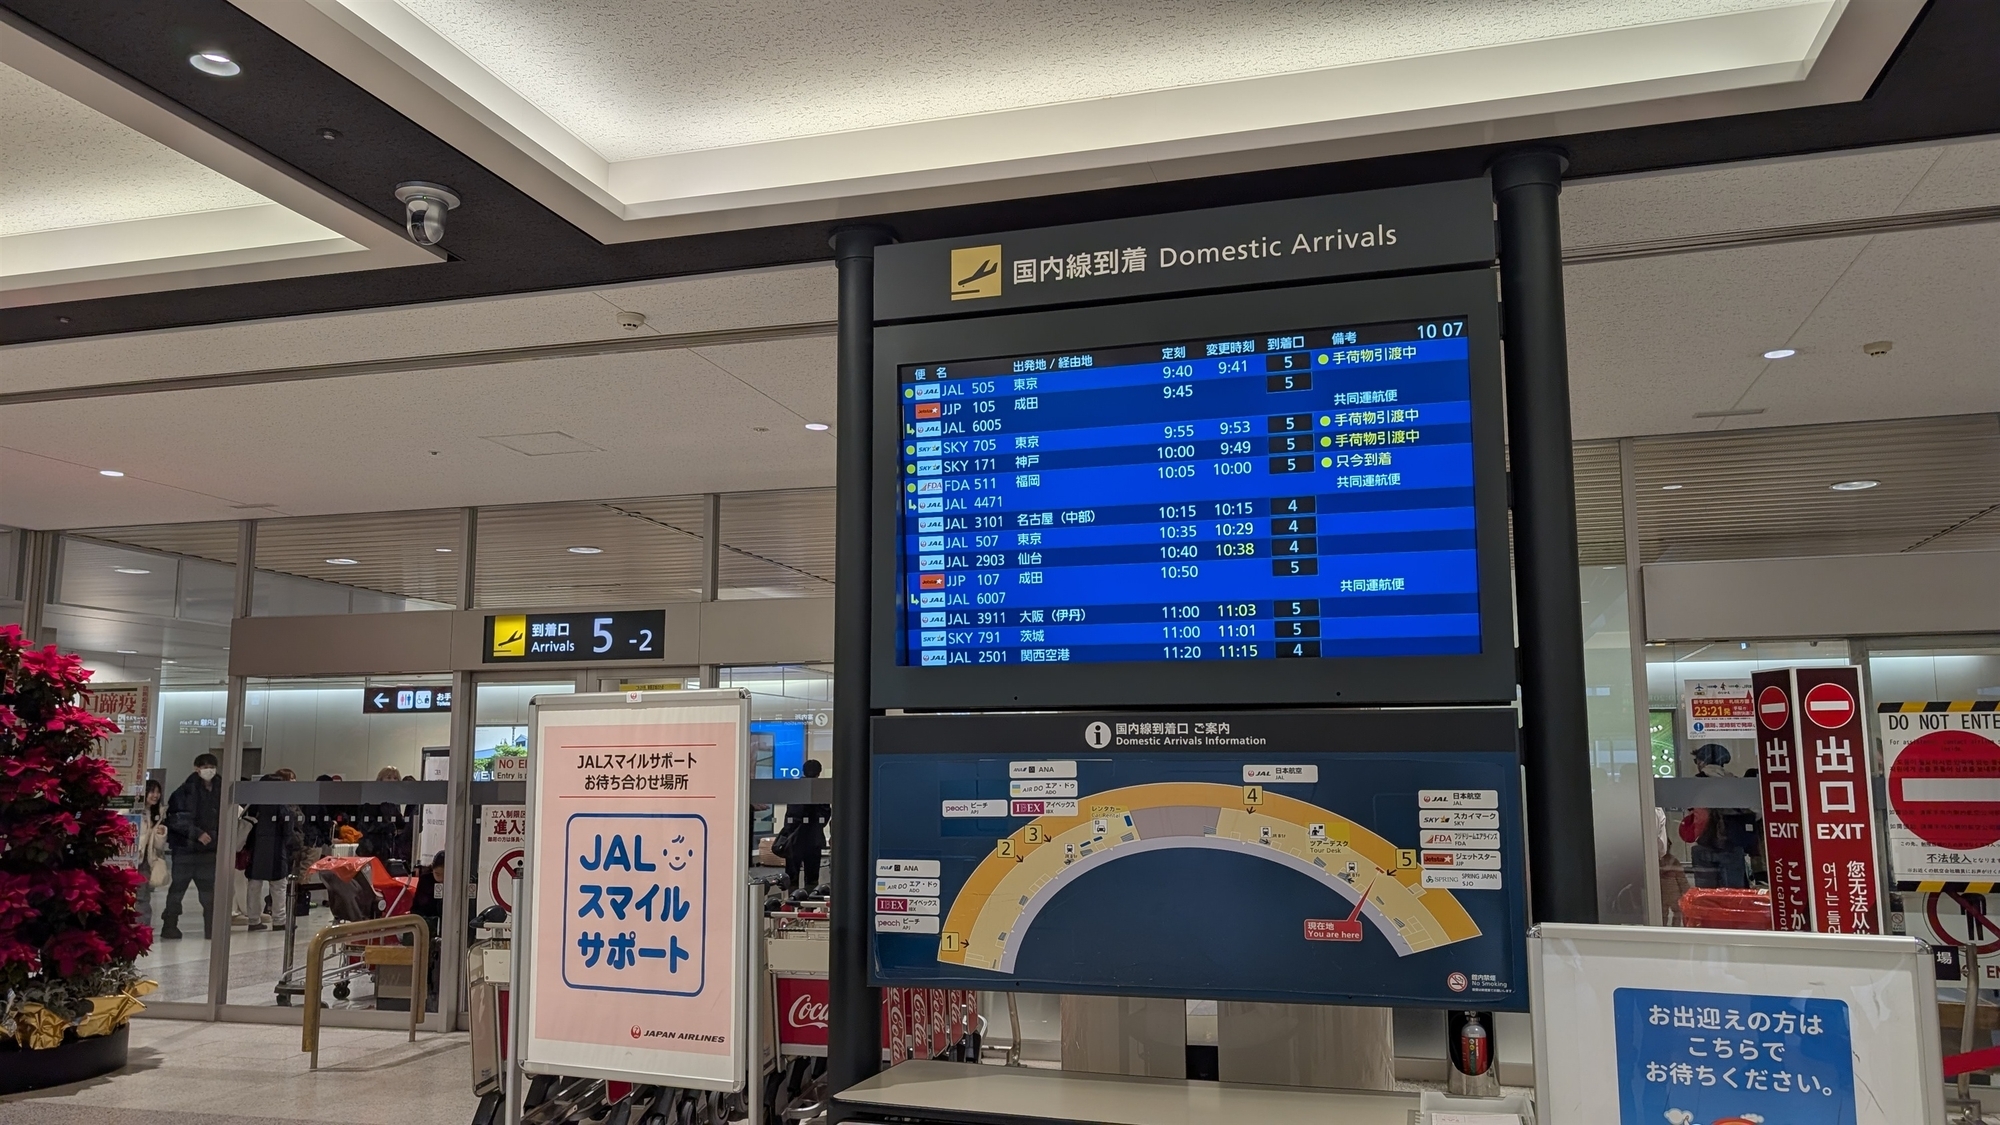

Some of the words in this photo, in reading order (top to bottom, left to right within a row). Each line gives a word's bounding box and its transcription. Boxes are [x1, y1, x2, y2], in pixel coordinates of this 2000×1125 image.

[1013, 246, 1147, 285] 国内線到着
[1160, 235, 1282, 268] Domestic
[1291, 224, 1397, 254] Arrivals
[1013, 359, 1046, 373] 出発地
[1058, 355, 1093, 369] 経由地
[1162, 347, 1186, 360] 定刻
[1206, 340, 1255, 357] 変更時刻
[1267, 336, 1304, 351] 到着口
[1332, 332, 1357, 346] 備考
[1417, 324, 1437, 340] 10
[1443, 322, 1464, 338] 07
[942, 384, 964, 396] JAL
[972, 382, 995, 393] 505
[1014, 378, 1038, 391] 東京
[1163, 364, 1193, 379] 9:40
[1218, 360, 1247, 374] 9:41
[1332, 345, 1417, 365] 手荷物引渡中
[942, 404, 961, 416] JJP
[973, 401, 995, 413] 105
[1014, 397, 1039, 411] 成田
[1163, 385, 1194, 399] 9:45
[943, 422, 966, 434] JAL
[973, 419, 1002, 432] 6005
[1334, 389, 1398, 405] 共同運航便
[944, 441, 969, 453] SKY
[973, 439, 996, 451] 705
[1015, 436, 1039, 449] 東京
[1164, 425, 1194, 439] 9:55
[1220, 420, 1250, 435] 9:53
[1335, 409, 1419, 428] 手荷物引渡中
[944, 460, 969, 472] SKY
[974, 458, 996, 470] 171
[1015, 455, 1040, 468] 神戸
[1157, 445, 1195, 459] 10:00
[1220, 441, 1251, 455] 9:49
[1335, 430, 1420, 448] 手荷物引渡中
[945, 479, 970, 492] FDA
[975, 478, 996, 489] 511
[1016, 474, 1040, 488] 福岡
[1158, 465, 1195, 479] 10:05
[1213, 461, 1252, 476] 10:00
[1337, 452, 1392, 468] 只今到着
[945, 498, 967, 511] JAL
[974, 496, 1003, 508] 4471
[1337, 473, 1401, 488] 共同運航便
[946, 518, 968, 530] JAL
[975, 516, 1003, 528] 3101
[1159, 506, 1196, 519] 10:15
[1215, 502, 1253, 515] 10:15
[946, 537, 968, 549] JAL
[976, 535, 999, 547] 507
[1018, 533, 1042, 545] 東京
[1160, 526, 1197, 539] 10:35
[1215, 522, 1254, 536] 10:29
[946, 556, 969, 568] JAL
[976, 554, 1005, 567] 2903
[1018, 553, 1042, 565] 仙台
[1160, 546, 1198, 559] 10:40
[1216, 543, 1255, 556] 10:38
[947, 575, 966, 587] JJP
[978, 574, 1000, 585] 107
[1019, 572, 1043, 585] 成田
[1161, 566, 1199, 579] 10:50
[947, 594, 970, 606] JAL
[977, 592, 1006, 604] 6007
[1341, 578, 1405, 592] 共同運航便
[948, 613, 970, 625] JAL
[978, 612, 1006, 624] 3911
[1162, 606, 1200, 619] 11:00
[1218, 604, 1257, 617] 11:03
[532, 623, 570, 638] 到着口
[592, 618, 613, 653] 5
[949, 633, 973, 644] SKY
[978, 632, 1000, 643] 791
[1020, 630, 1044, 643] 茨城
[1163, 626, 1200, 639] 11:00
[1218, 624, 1256, 637] 11:01
[532, 641, 575, 653] Arrivals
[949, 652, 971, 664] JAL
[979, 651, 1007, 663] 2501
[1021, 649, 1070, 662] 関西空港
[1164, 646, 1201, 659] 11:20
[1219, 644, 1258, 658] 11:15
[1116, 723, 1189, 735] 国内線到着口
[1195, 722, 1230, 735] ご案内
[1889, 715, 1909, 730] DO
[1920, 714, 1950, 730] NOT
[1116, 736, 1161, 746] Domestic
[1164, 736, 1203, 746] Arrivals
[1205, 736, 1266, 745] Information
[499, 760, 514, 769] NO
[577, 752, 697, 769] JALスマイルサポート
[497, 772, 515, 780] Entry
[585, 774, 689, 791] お待ち合わせ場所
[1766, 738, 1793, 813] 出口
[1816, 736, 1856, 814] 出口
[1247, 788, 1258, 803] 4
[945, 805, 968, 813] peach
[1016, 803, 1041, 813] IBEX
[1029, 827, 1038, 841] 3
[1770, 822, 1799, 839] EXIT
[1817, 824, 1865, 840] EXIT
[580, 834, 657, 872] JAL
[1002, 842, 1011, 856] 2
[1402, 852, 1412, 867] 5
[1775, 858, 1784, 883] You
[578, 884, 690, 923] スマイル
[1308, 922, 1335, 930] 現在地
[578, 931, 690, 974] サポート
[947, 935, 952, 949] 1
[1649, 1004, 1824, 1035] お出迎えの方は
[644, 1030, 676, 1040] JAPAN
[678, 1032, 726, 1044] AIRLINES
[1689, 1037, 1786, 1062] こちらで
[1646, 1061, 1832, 1096] お待ちください。
